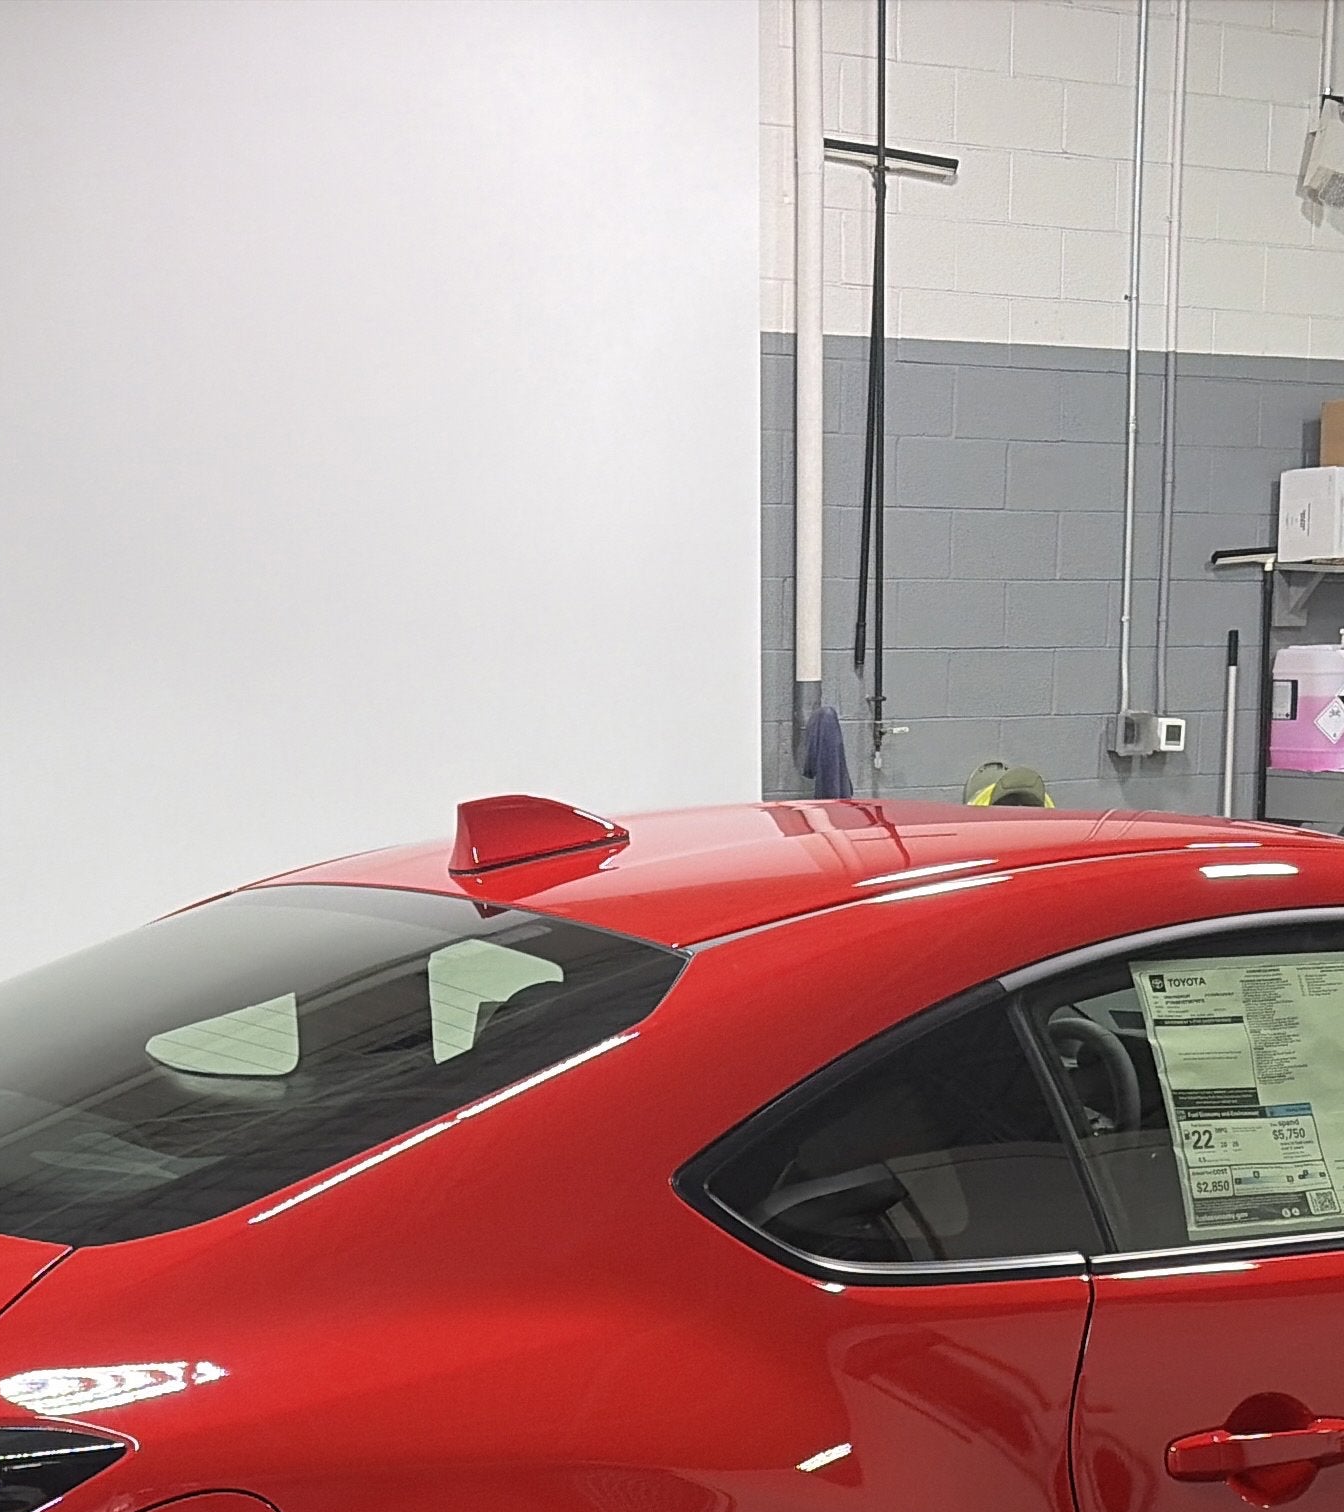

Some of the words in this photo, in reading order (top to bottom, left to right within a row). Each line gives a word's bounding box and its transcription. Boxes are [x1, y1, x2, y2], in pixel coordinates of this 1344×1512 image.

[1167, 977, 1206, 988] TOYOTA
[1278, 1118, 1299, 1128] spend
[1191, 1129, 1215, 1150] 22
[1272, 1127, 1306, 1141] $5,750
[1196, 1180, 1230, 1193] $2,850
